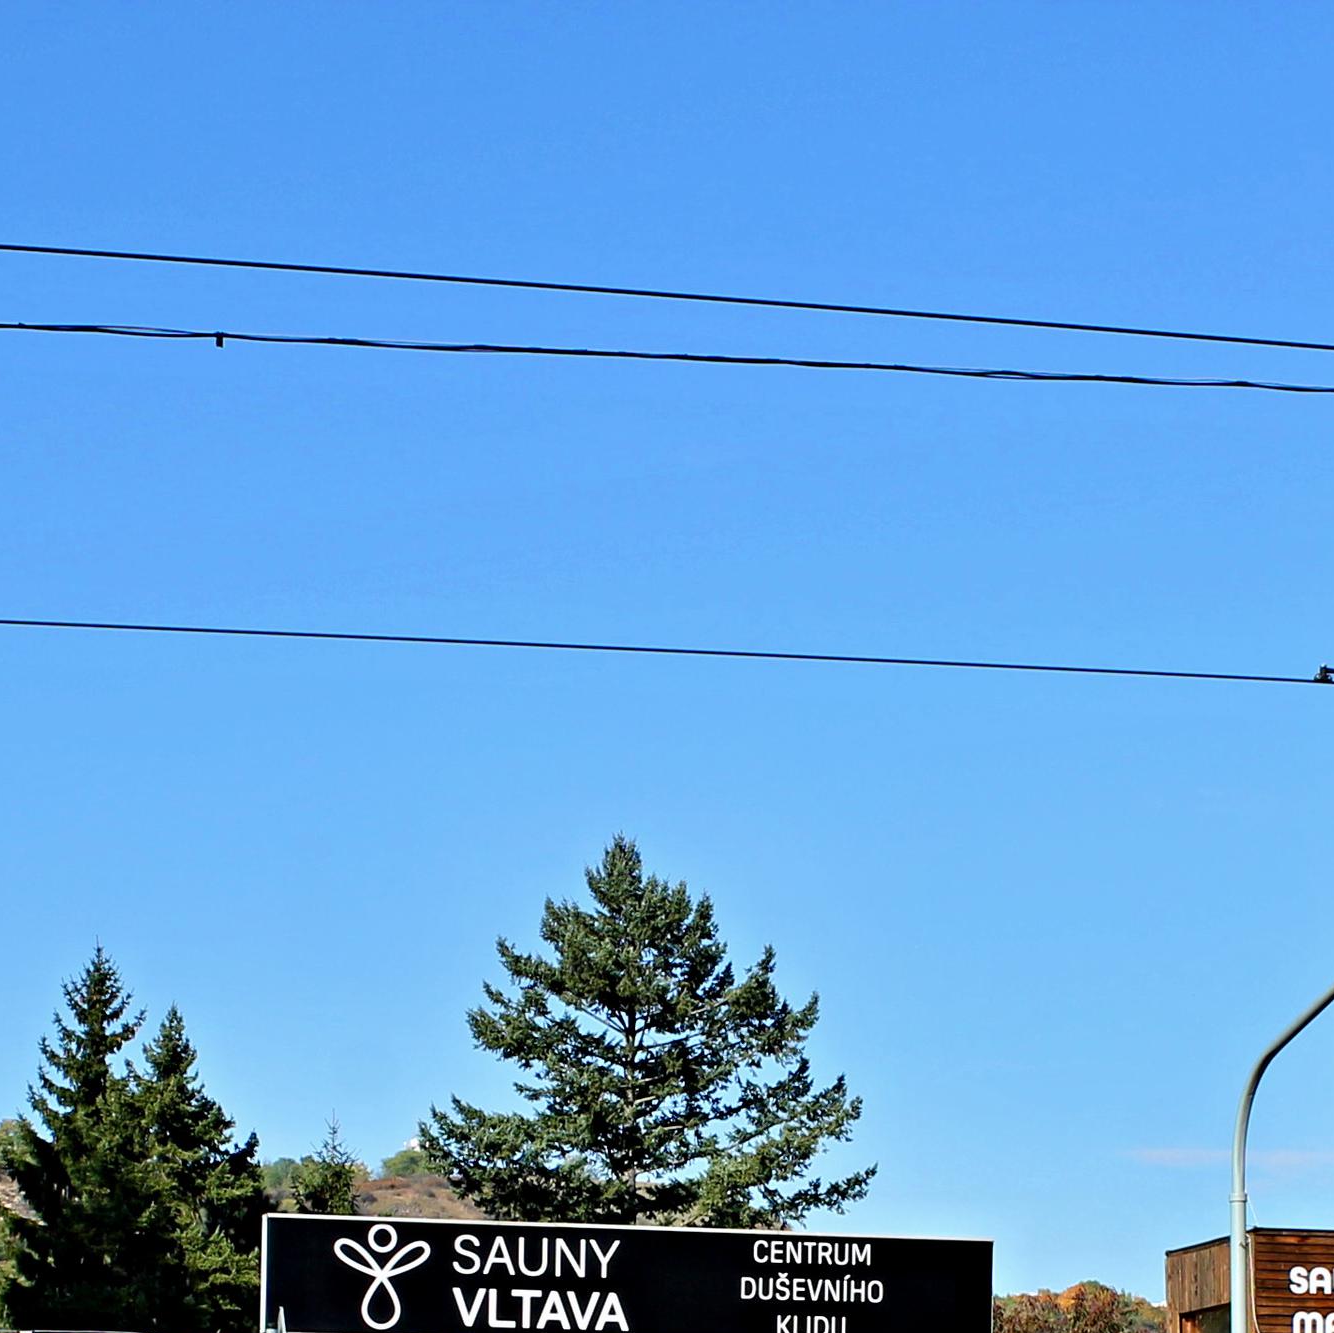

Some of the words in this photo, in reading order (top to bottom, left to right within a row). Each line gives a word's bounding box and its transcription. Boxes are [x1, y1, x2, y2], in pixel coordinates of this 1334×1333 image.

[451, 1233, 622, 1279] SAUNY
[752, 1239, 872, 1267] CENTRUM
[739, 1270, 885, 1304] DUŠEVNÍHO
[451, 1287, 629, 1333] VLTAVA
